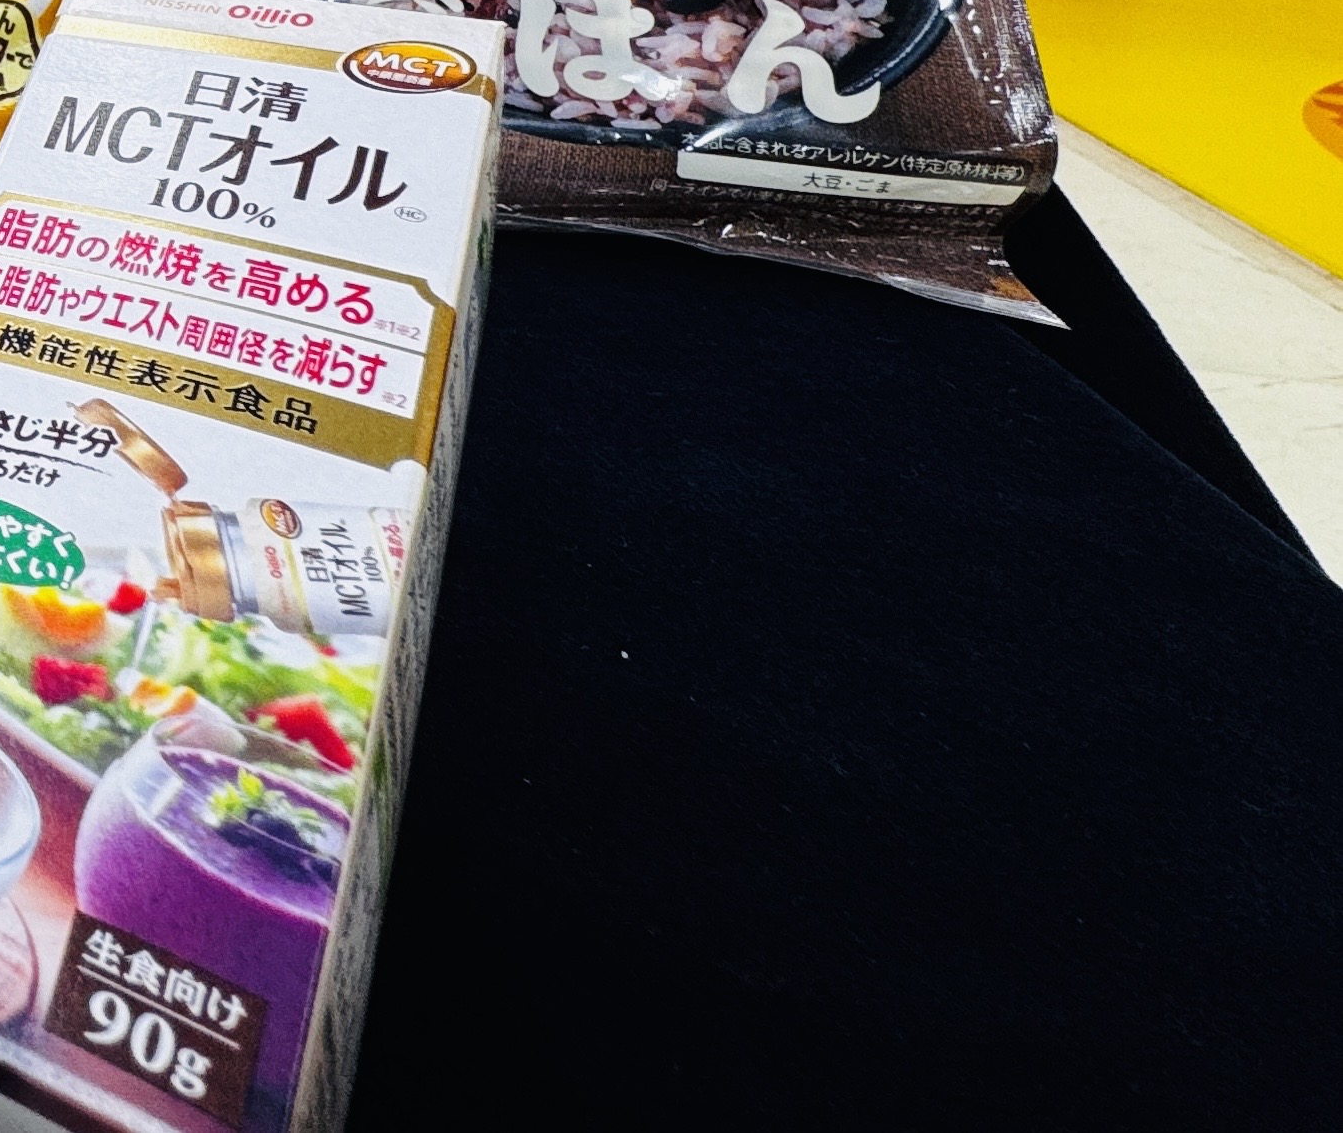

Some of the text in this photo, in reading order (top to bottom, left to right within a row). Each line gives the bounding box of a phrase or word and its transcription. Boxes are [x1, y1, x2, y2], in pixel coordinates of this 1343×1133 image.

[361, 50, 459, 78] MCT
[184, 70, 308, 123] 日清
[43, 96, 409, 213] MCTオイル
[148, 176, 278, 230] 100%
[802, 173, 892, 195] 大豆・ごま
[80, 928, 248, 1033] 生食向け
[84, 987, 213, 1103] 90g
